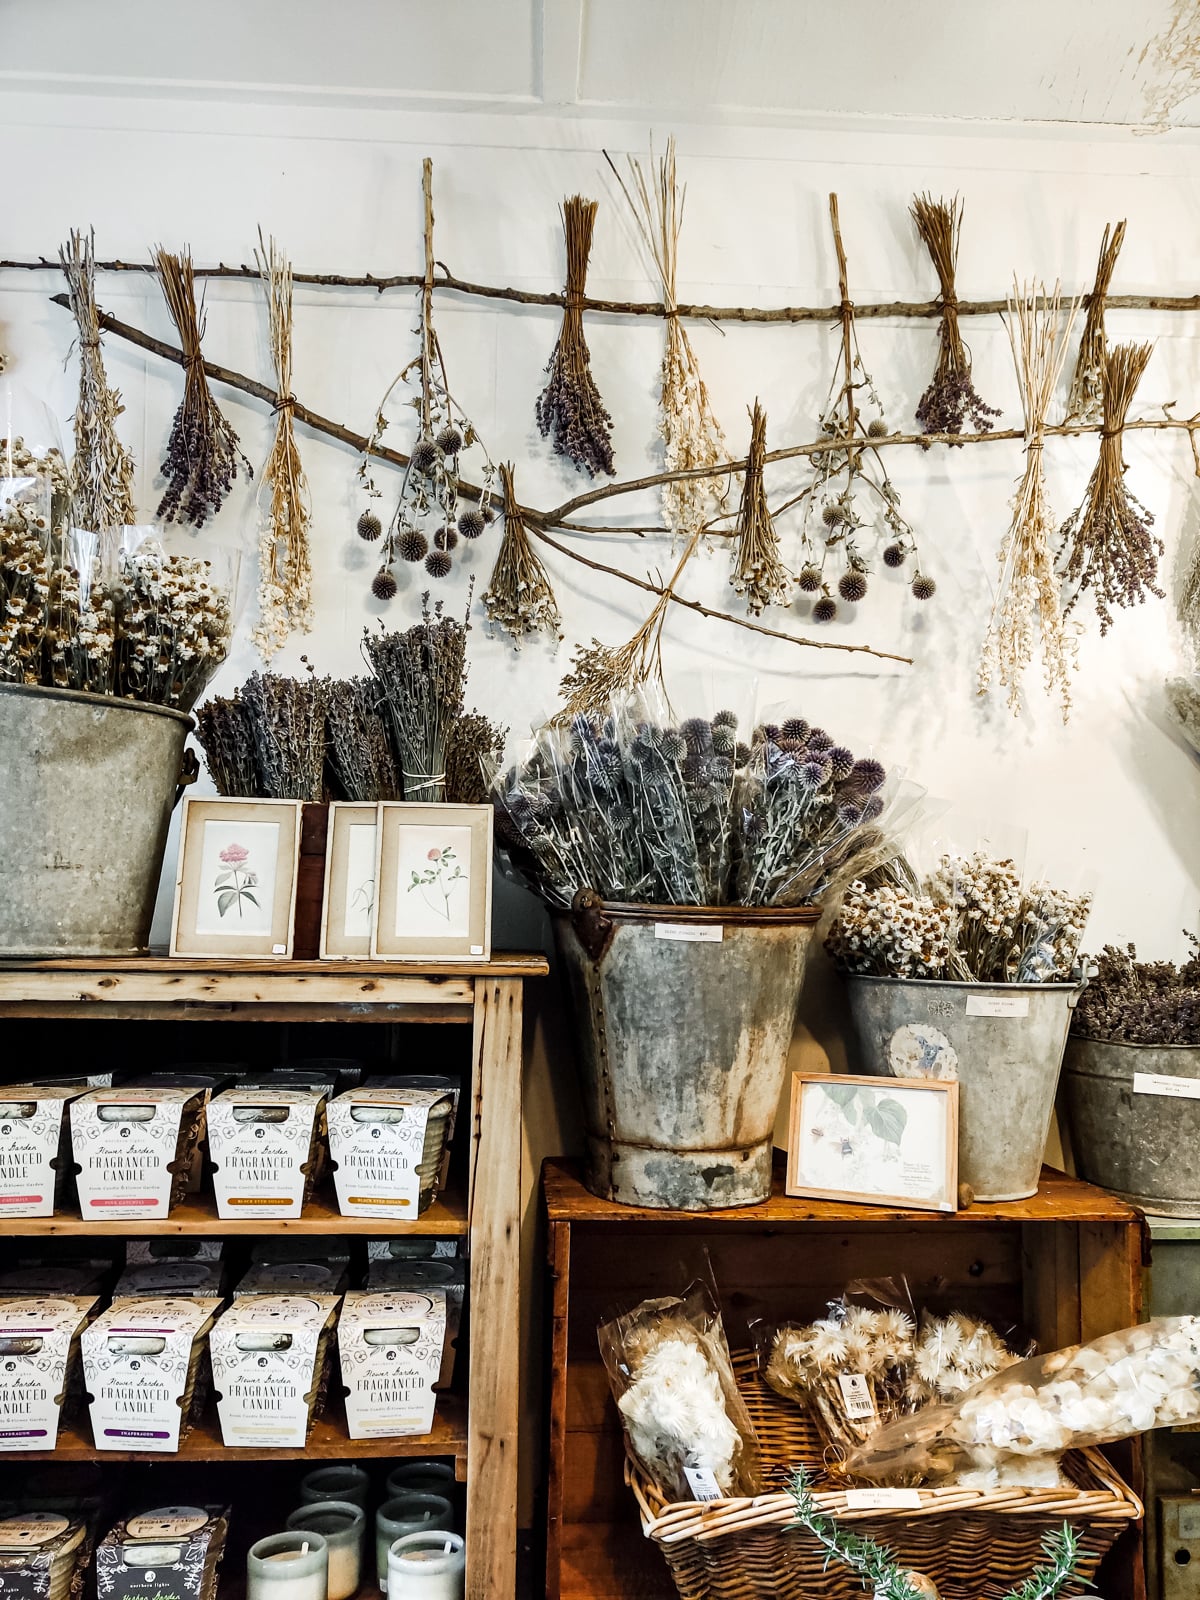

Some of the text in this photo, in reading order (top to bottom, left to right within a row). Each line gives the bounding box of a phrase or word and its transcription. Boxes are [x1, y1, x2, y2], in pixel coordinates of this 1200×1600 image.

[8, 1142, 36, 1151] Garden
[126, 1145, 154, 1154] Garden
[261, 1145, 288, 1154] Garden
[378, 1146, 403, 1156] Garden
[0, 1153, 42, 1165] RANCED
[90, 1156, 160, 1168] FRAGRANCED
[226, 1156, 293, 1168] FRAGRANCED
[344, 1155, 408, 1168] FRAGRANCED
[1, 1167, 28, 1178] NDLE
[104, 1170, 144, 1181] CANDLE
[240, 1170, 279, 1181] CANDLE
[358, 1169, 395, 1181] CANDLE
[392, 1367, 419, 1376] Garden
[12, 1378, 41, 1387] Garden
[137, 1378, 164, 1386] Garden
[264, 1374, 291, 1383] Garden
[357, 1377, 424, 1391] FRAGRANCED
[0, 1389, 46, 1401] RANCED
[102, 1388, 169, 1400] FRAGRANCED
[229, 1385, 296, 1397] FRAGRANCED
[371, 1391, 410, 1402] CANDLE
[0, 1402, 31, 1414] NDLE
[116, 1401, 155, 1413] CANDLE
[243, 1399, 282, 1410] CANDLE
